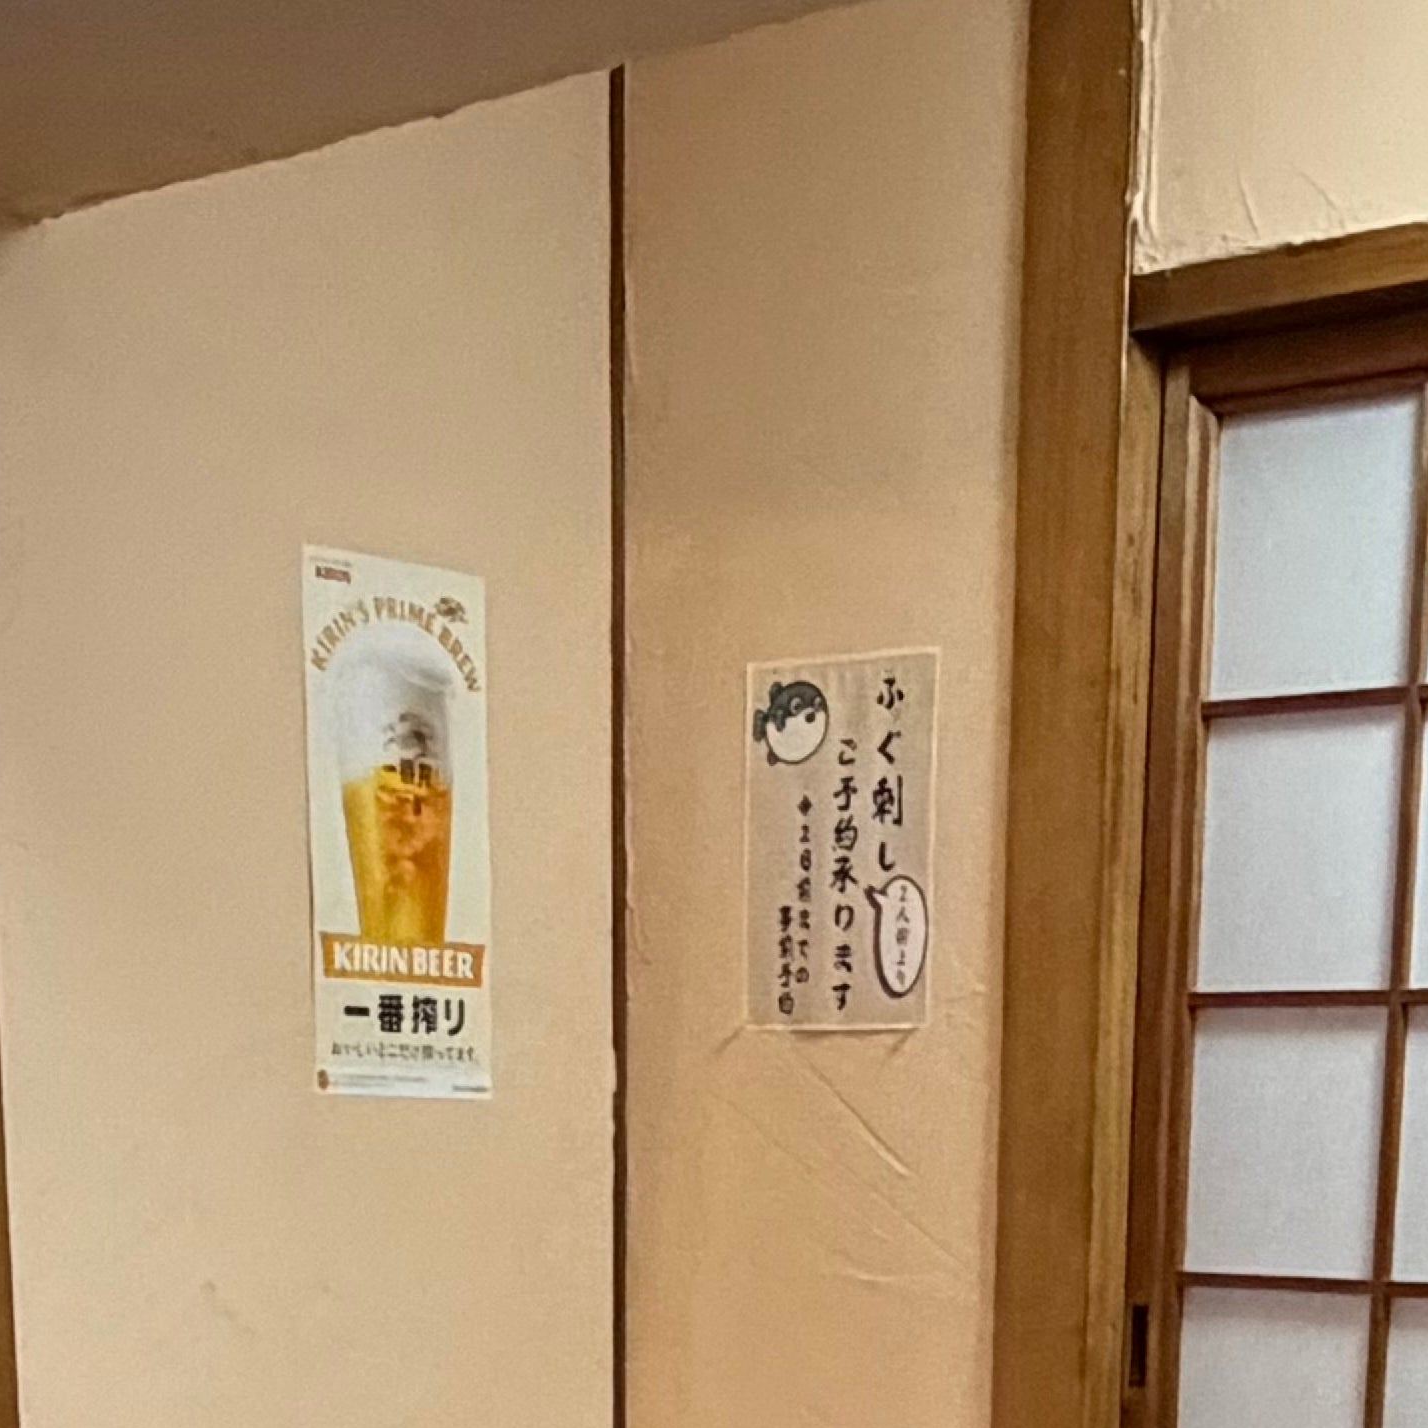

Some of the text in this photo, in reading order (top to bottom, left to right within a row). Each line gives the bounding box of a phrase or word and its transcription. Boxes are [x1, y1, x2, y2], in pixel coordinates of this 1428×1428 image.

[871, 675, 905, 873] ふぐ刺し
[332, 941, 474, 980] KIRIN BEER
[343, 994, 466, 1036] 一番搾り
